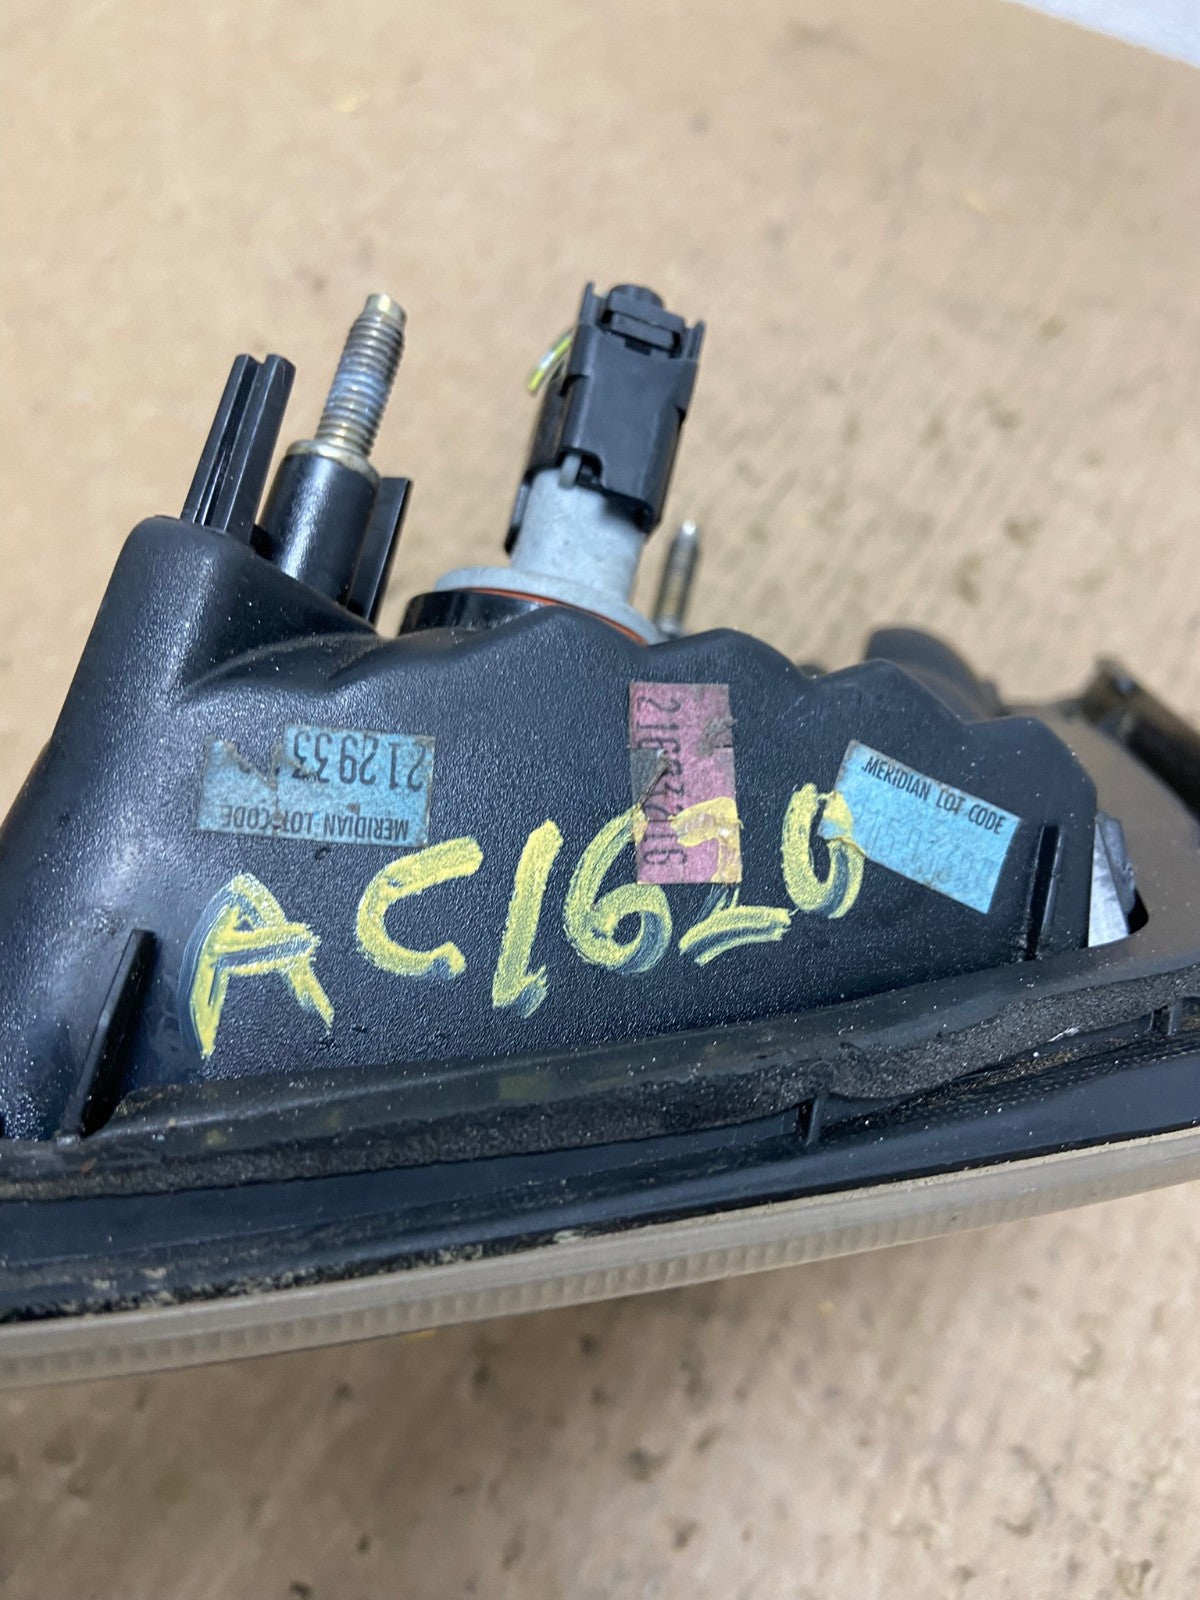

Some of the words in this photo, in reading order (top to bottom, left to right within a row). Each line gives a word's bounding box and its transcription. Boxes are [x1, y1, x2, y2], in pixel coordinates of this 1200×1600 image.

[862, 756, 932, 801] MERIDIAN
[935, 788, 966, 816] LOT
[967, 803, 1008, 836] CODE
[219, 803, 271, 830] CODE
[281, 809, 314, 834] LOT
[323, 812, 410, 841] MERIDIAN
